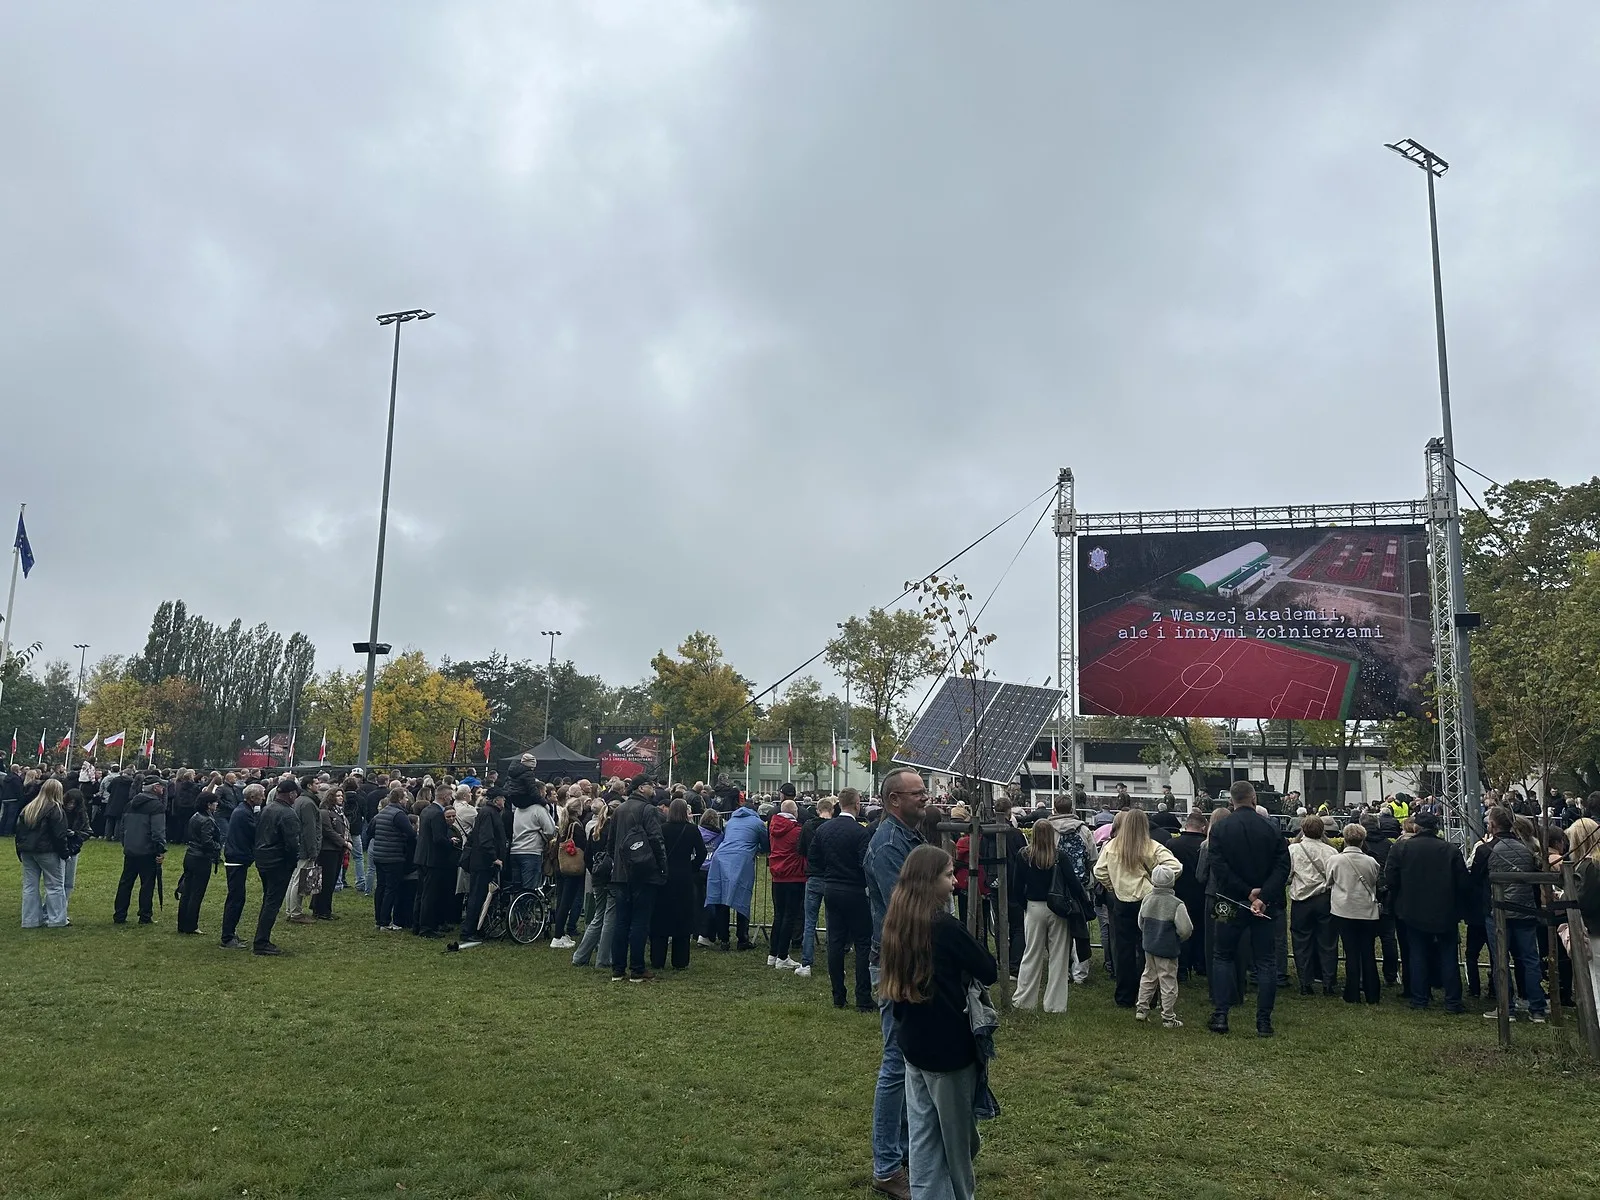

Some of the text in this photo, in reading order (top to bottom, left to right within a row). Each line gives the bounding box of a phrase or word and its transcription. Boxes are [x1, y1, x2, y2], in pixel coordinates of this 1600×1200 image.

[1152, 606, 1345, 624] z Waszej akademii,
[1118, 624, 1384, 641] ale i innymi żołnierzami
